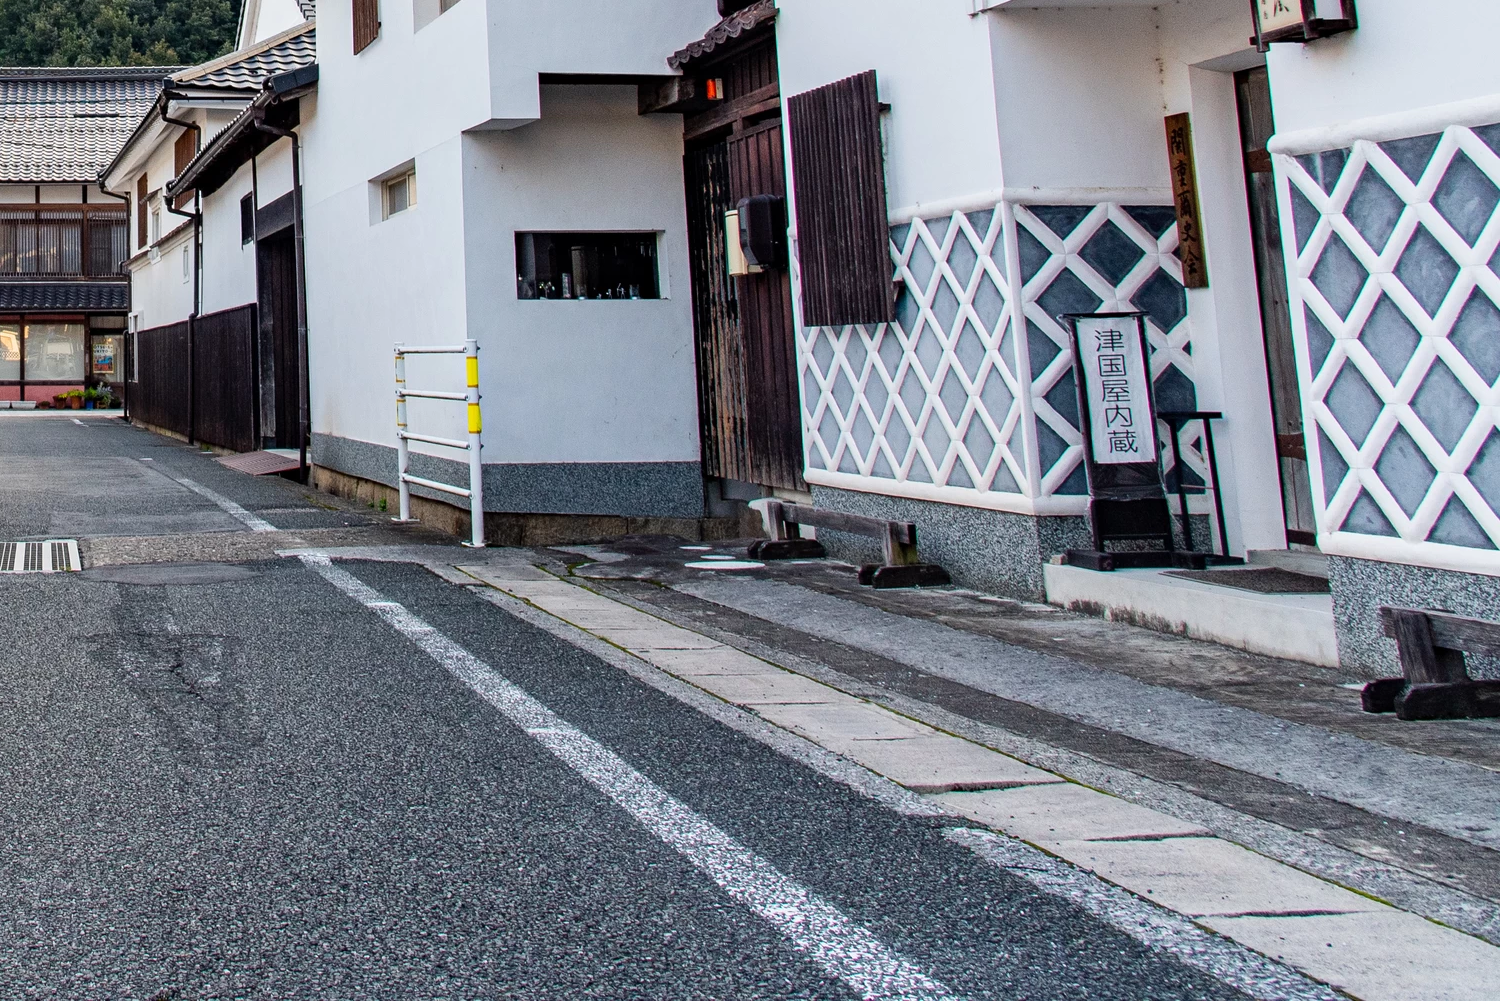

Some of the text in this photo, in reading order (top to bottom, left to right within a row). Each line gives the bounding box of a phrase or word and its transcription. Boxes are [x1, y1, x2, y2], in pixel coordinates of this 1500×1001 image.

[1094, 328, 1138, 453] 津国屋内蔵
